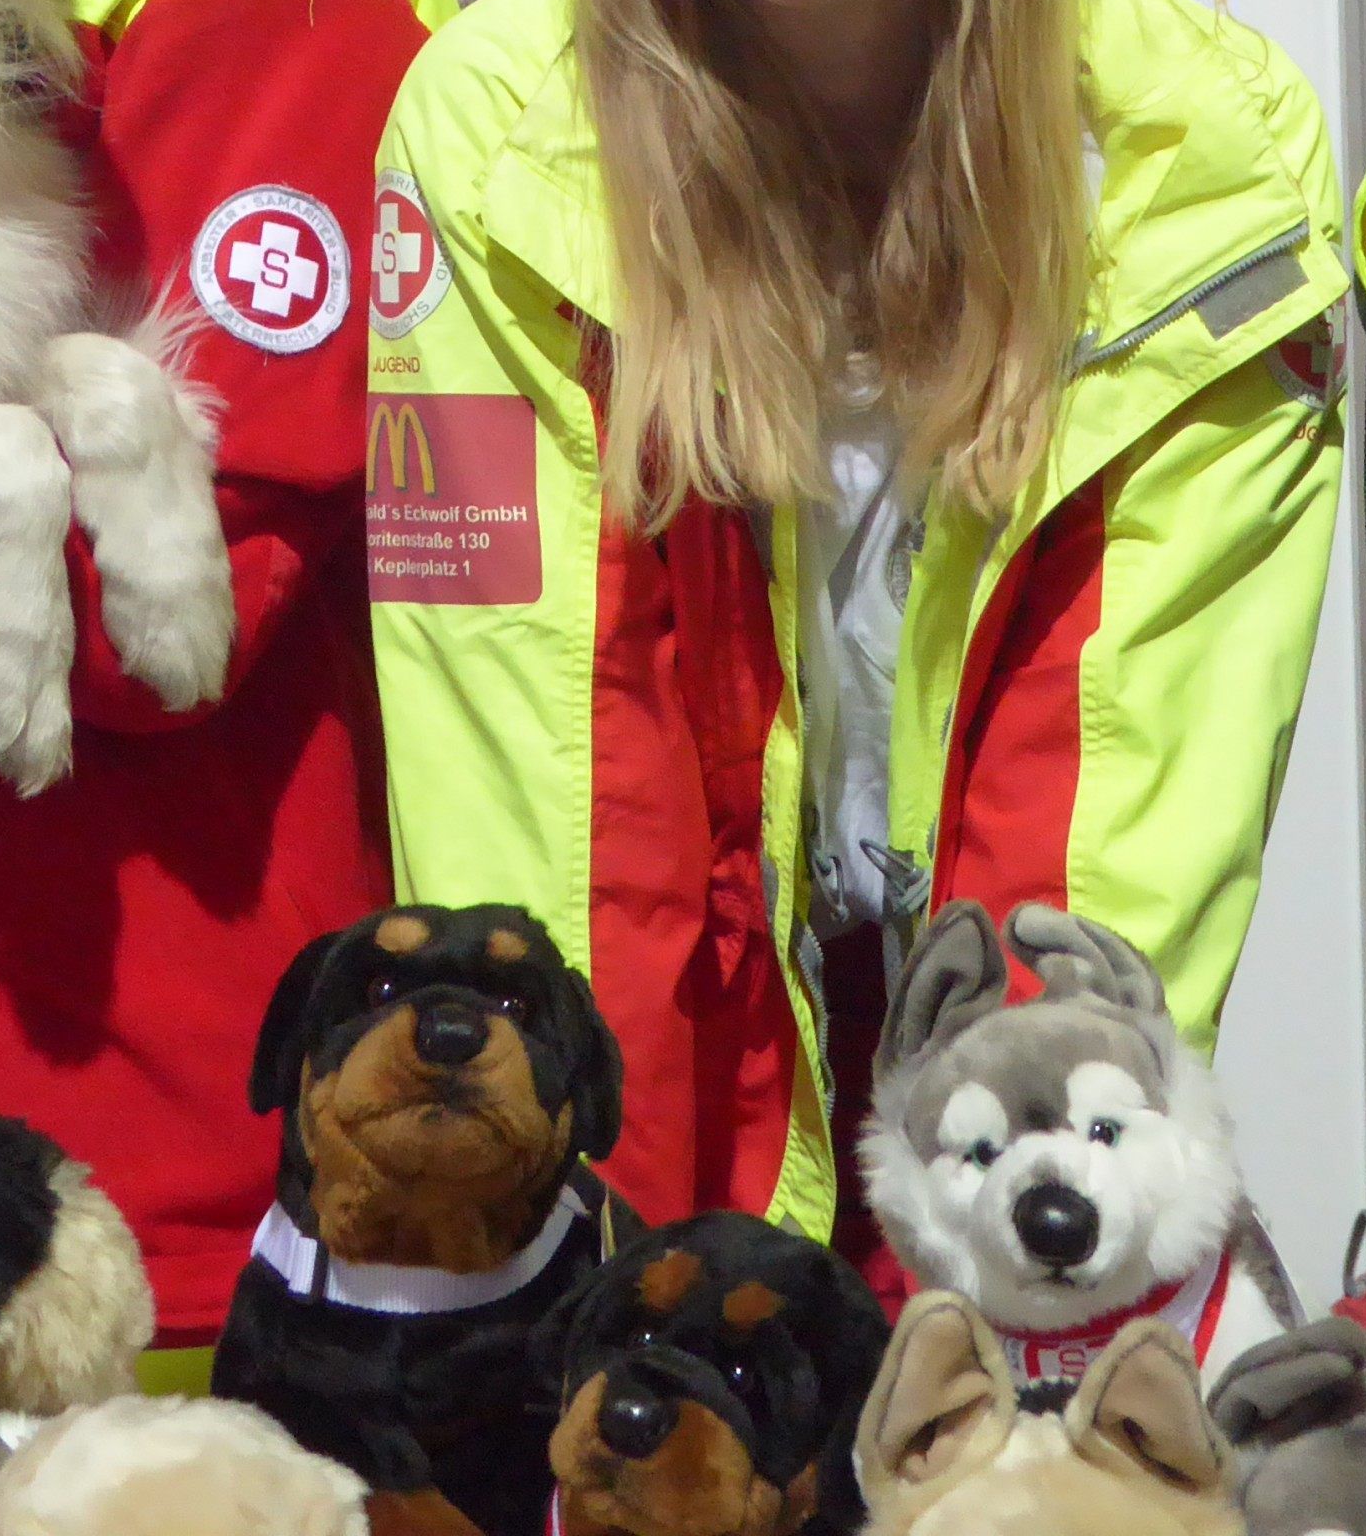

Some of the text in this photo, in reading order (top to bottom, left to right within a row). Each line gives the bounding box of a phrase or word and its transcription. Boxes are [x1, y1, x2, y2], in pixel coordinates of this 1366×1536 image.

[381, 232, 396, 274] S
[260, 248, 290, 289] S
[373, 356, 420, 373] JUGEND
[404, 504, 460, 523] Eckwolf
[465, 505, 528, 523] GmbH
[459, 532, 490, 550] 130
[374, 557, 471, 579] Keplerplatz 1
